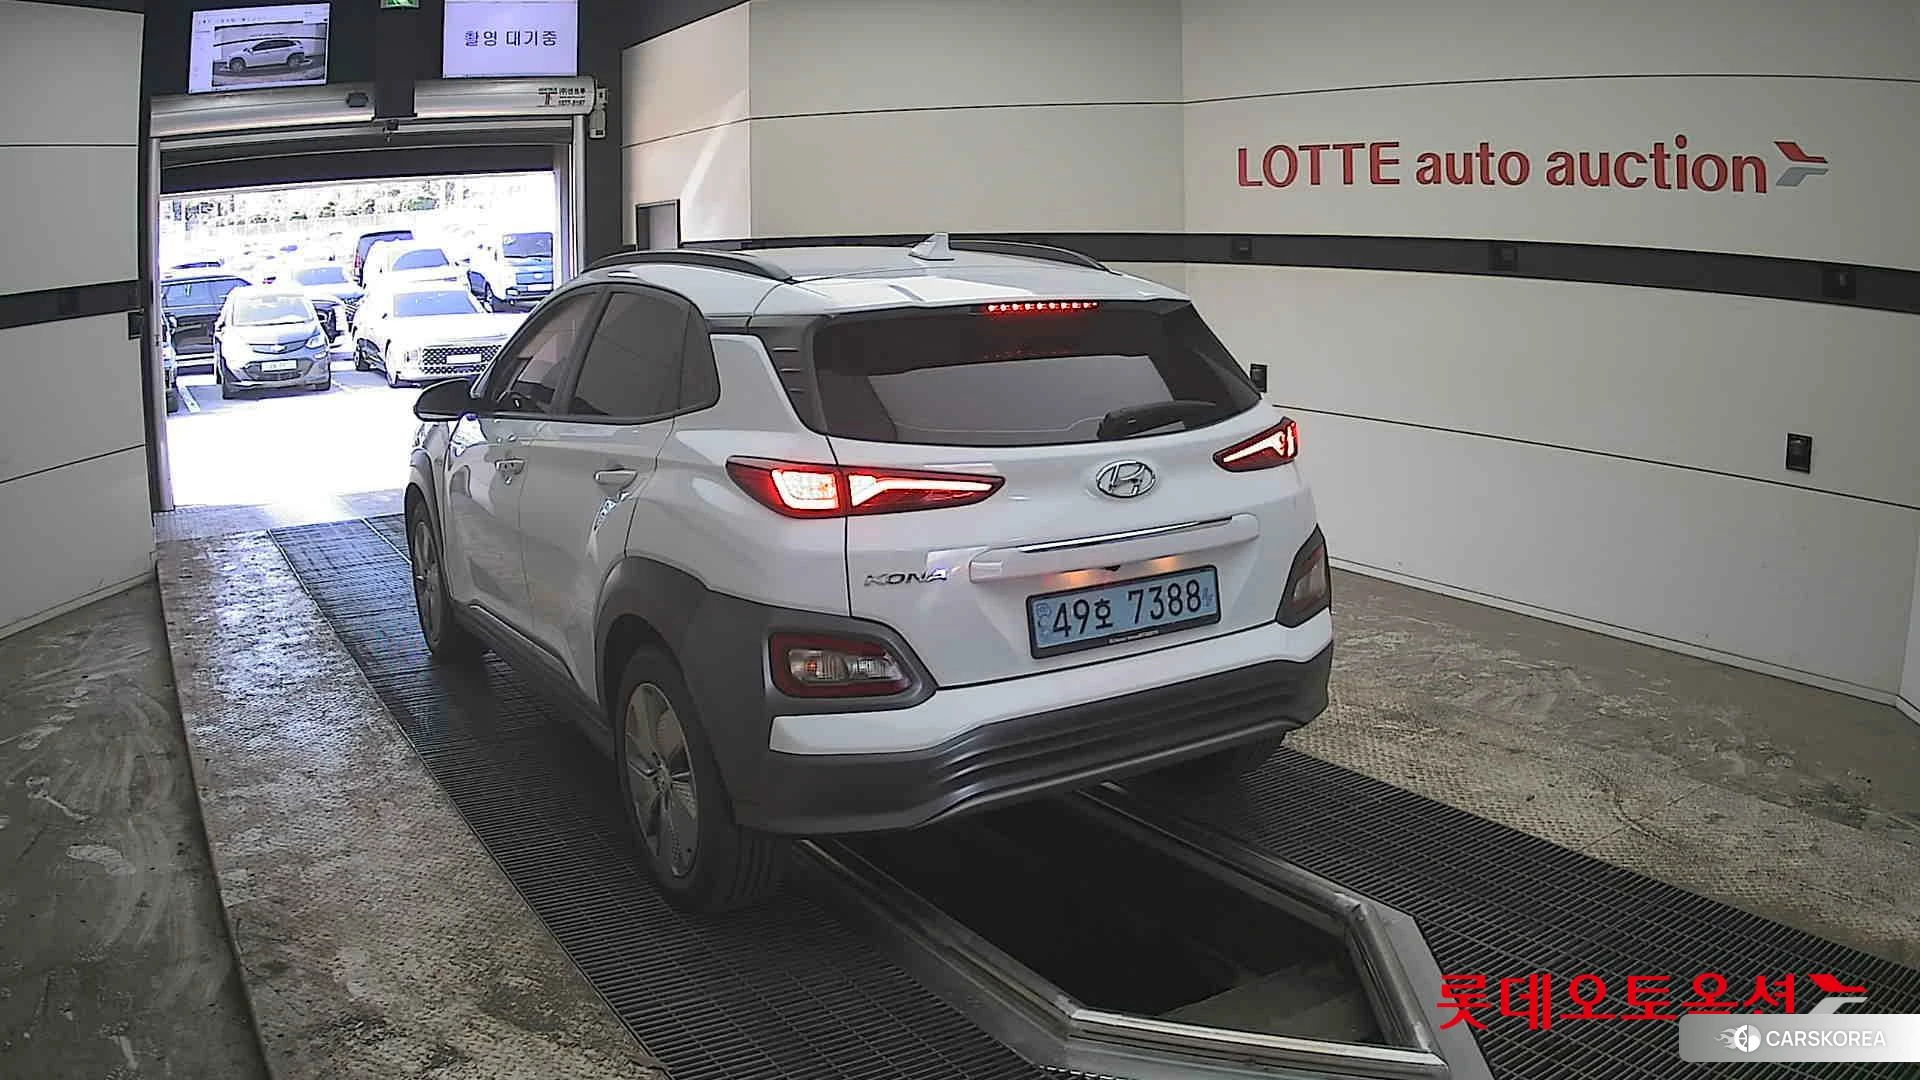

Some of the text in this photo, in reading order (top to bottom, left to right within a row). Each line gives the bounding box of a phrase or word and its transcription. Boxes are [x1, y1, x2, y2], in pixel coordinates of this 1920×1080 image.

[465, 30, 558, 47] 촬영 대기중
[1237, 134, 1767, 194] LOTTE auto auction
[864, 568, 947, 587] KONA
[1053, 579, 1201, 638] 49호 7388
